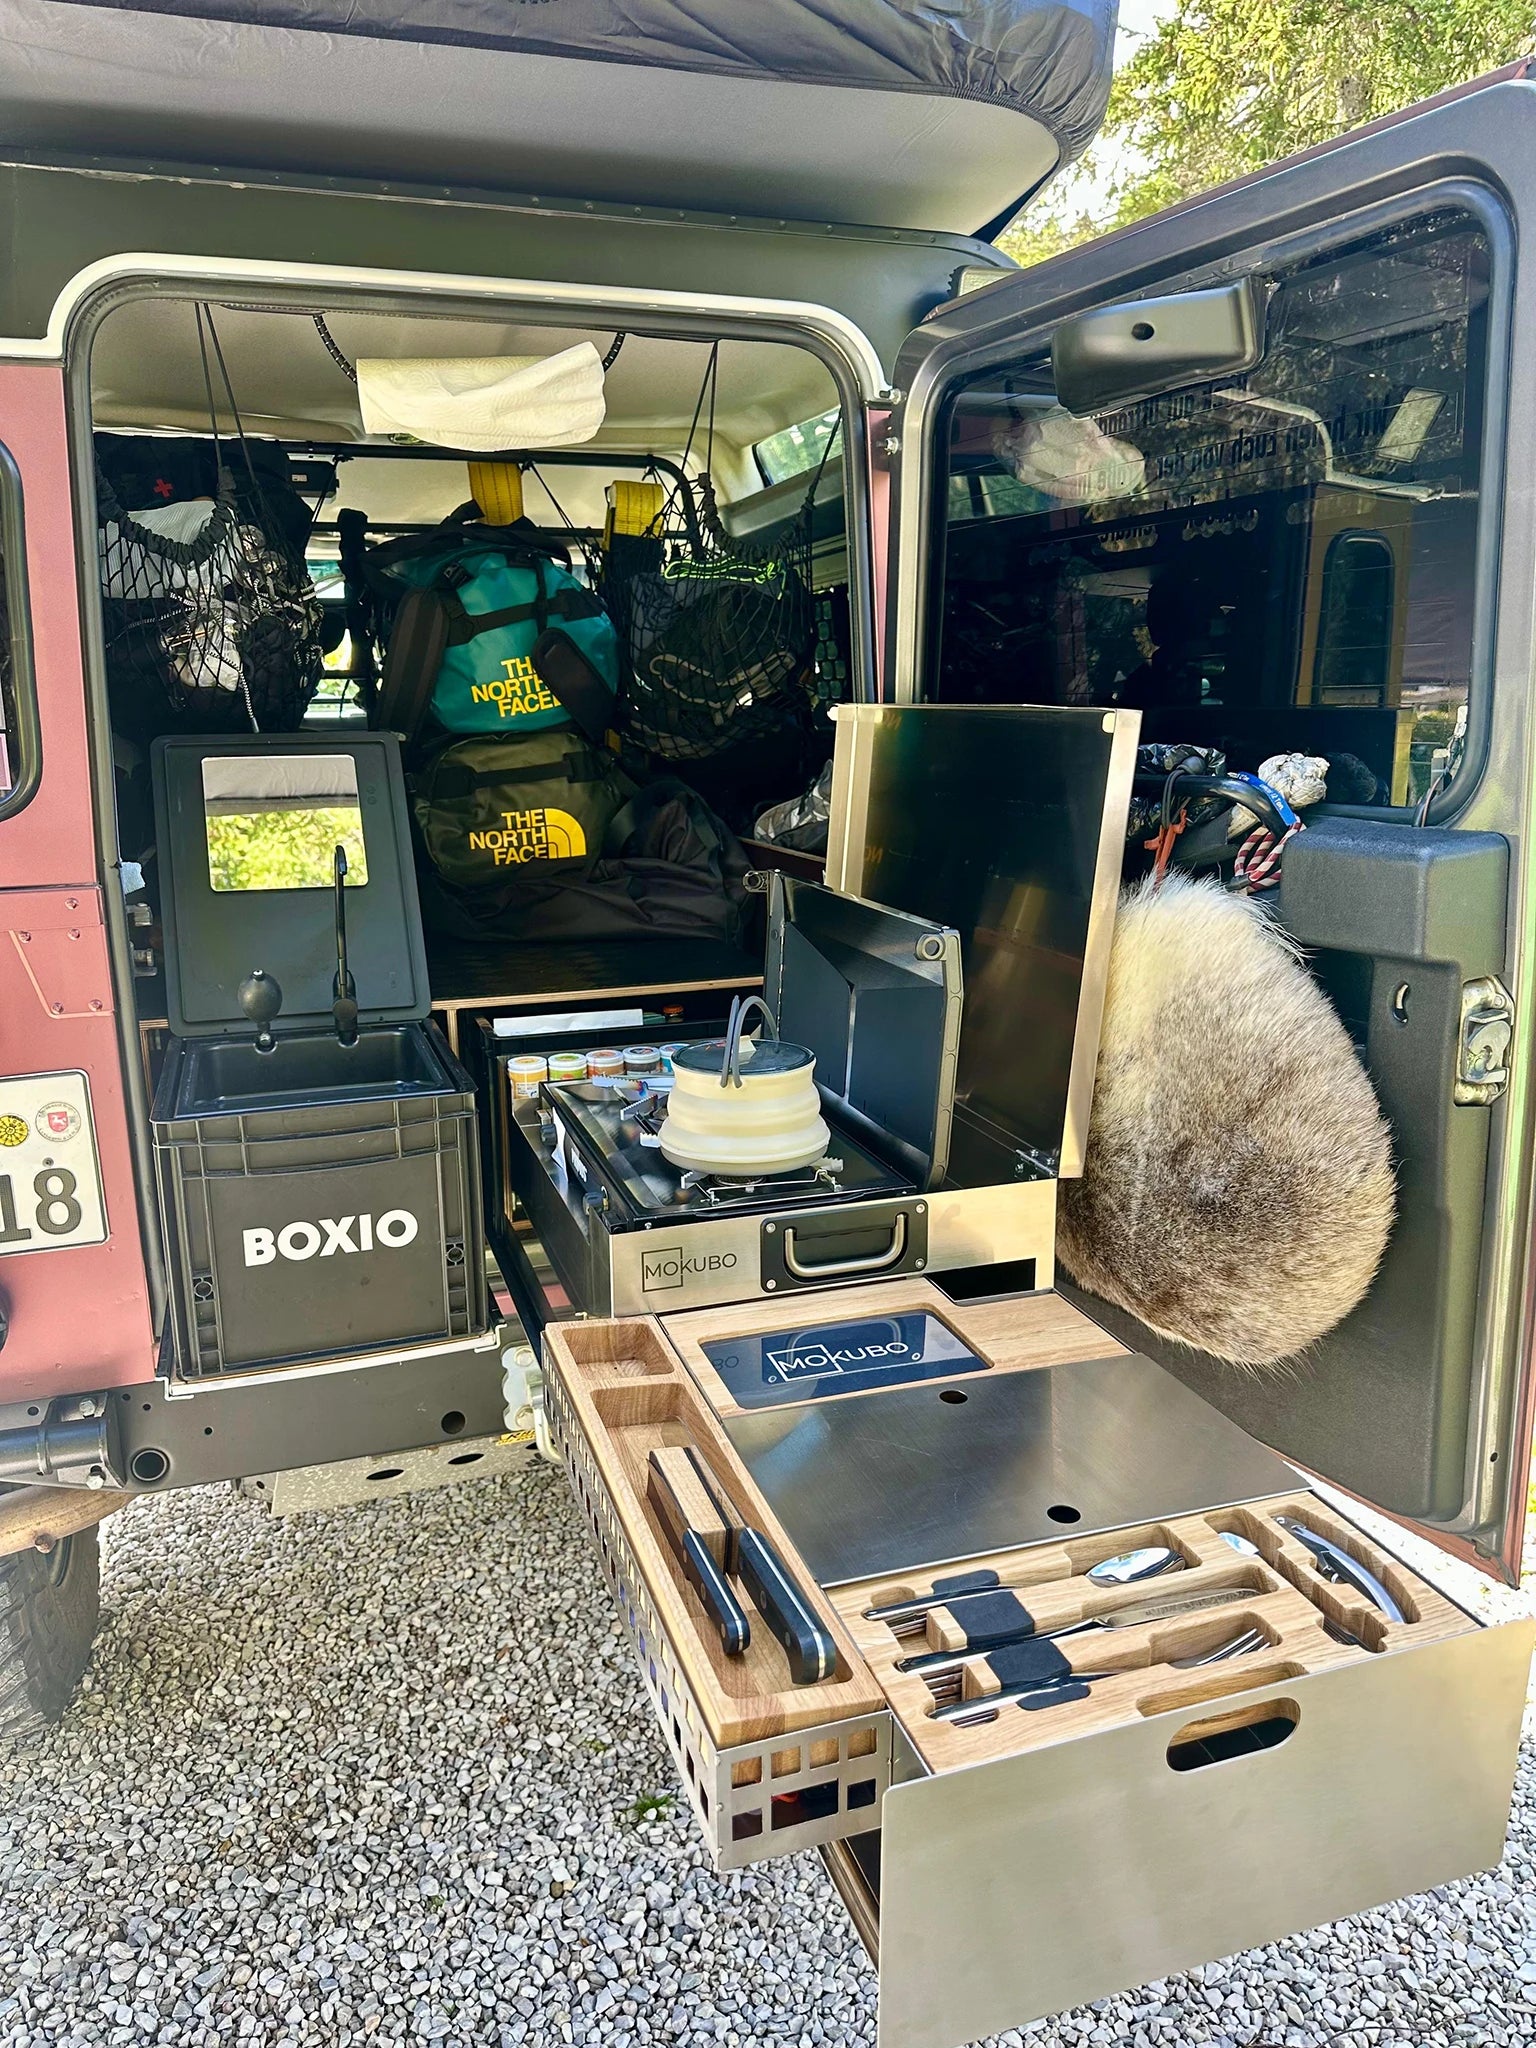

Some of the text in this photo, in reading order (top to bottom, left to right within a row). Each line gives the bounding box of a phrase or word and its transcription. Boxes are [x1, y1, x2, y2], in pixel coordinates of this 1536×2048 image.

[501, 656, 536, 678] TH
[498, 694, 551, 718] FACE
[501, 809, 544, 830] THE
[469, 827, 547, 849] NORTH
[493, 845, 548, 866] FACE
[242, 1209, 419, 1267] BOXIO
[644, 1252, 738, 1281] MOKUBO
[778, 1341, 910, 1374] MOKUBO
